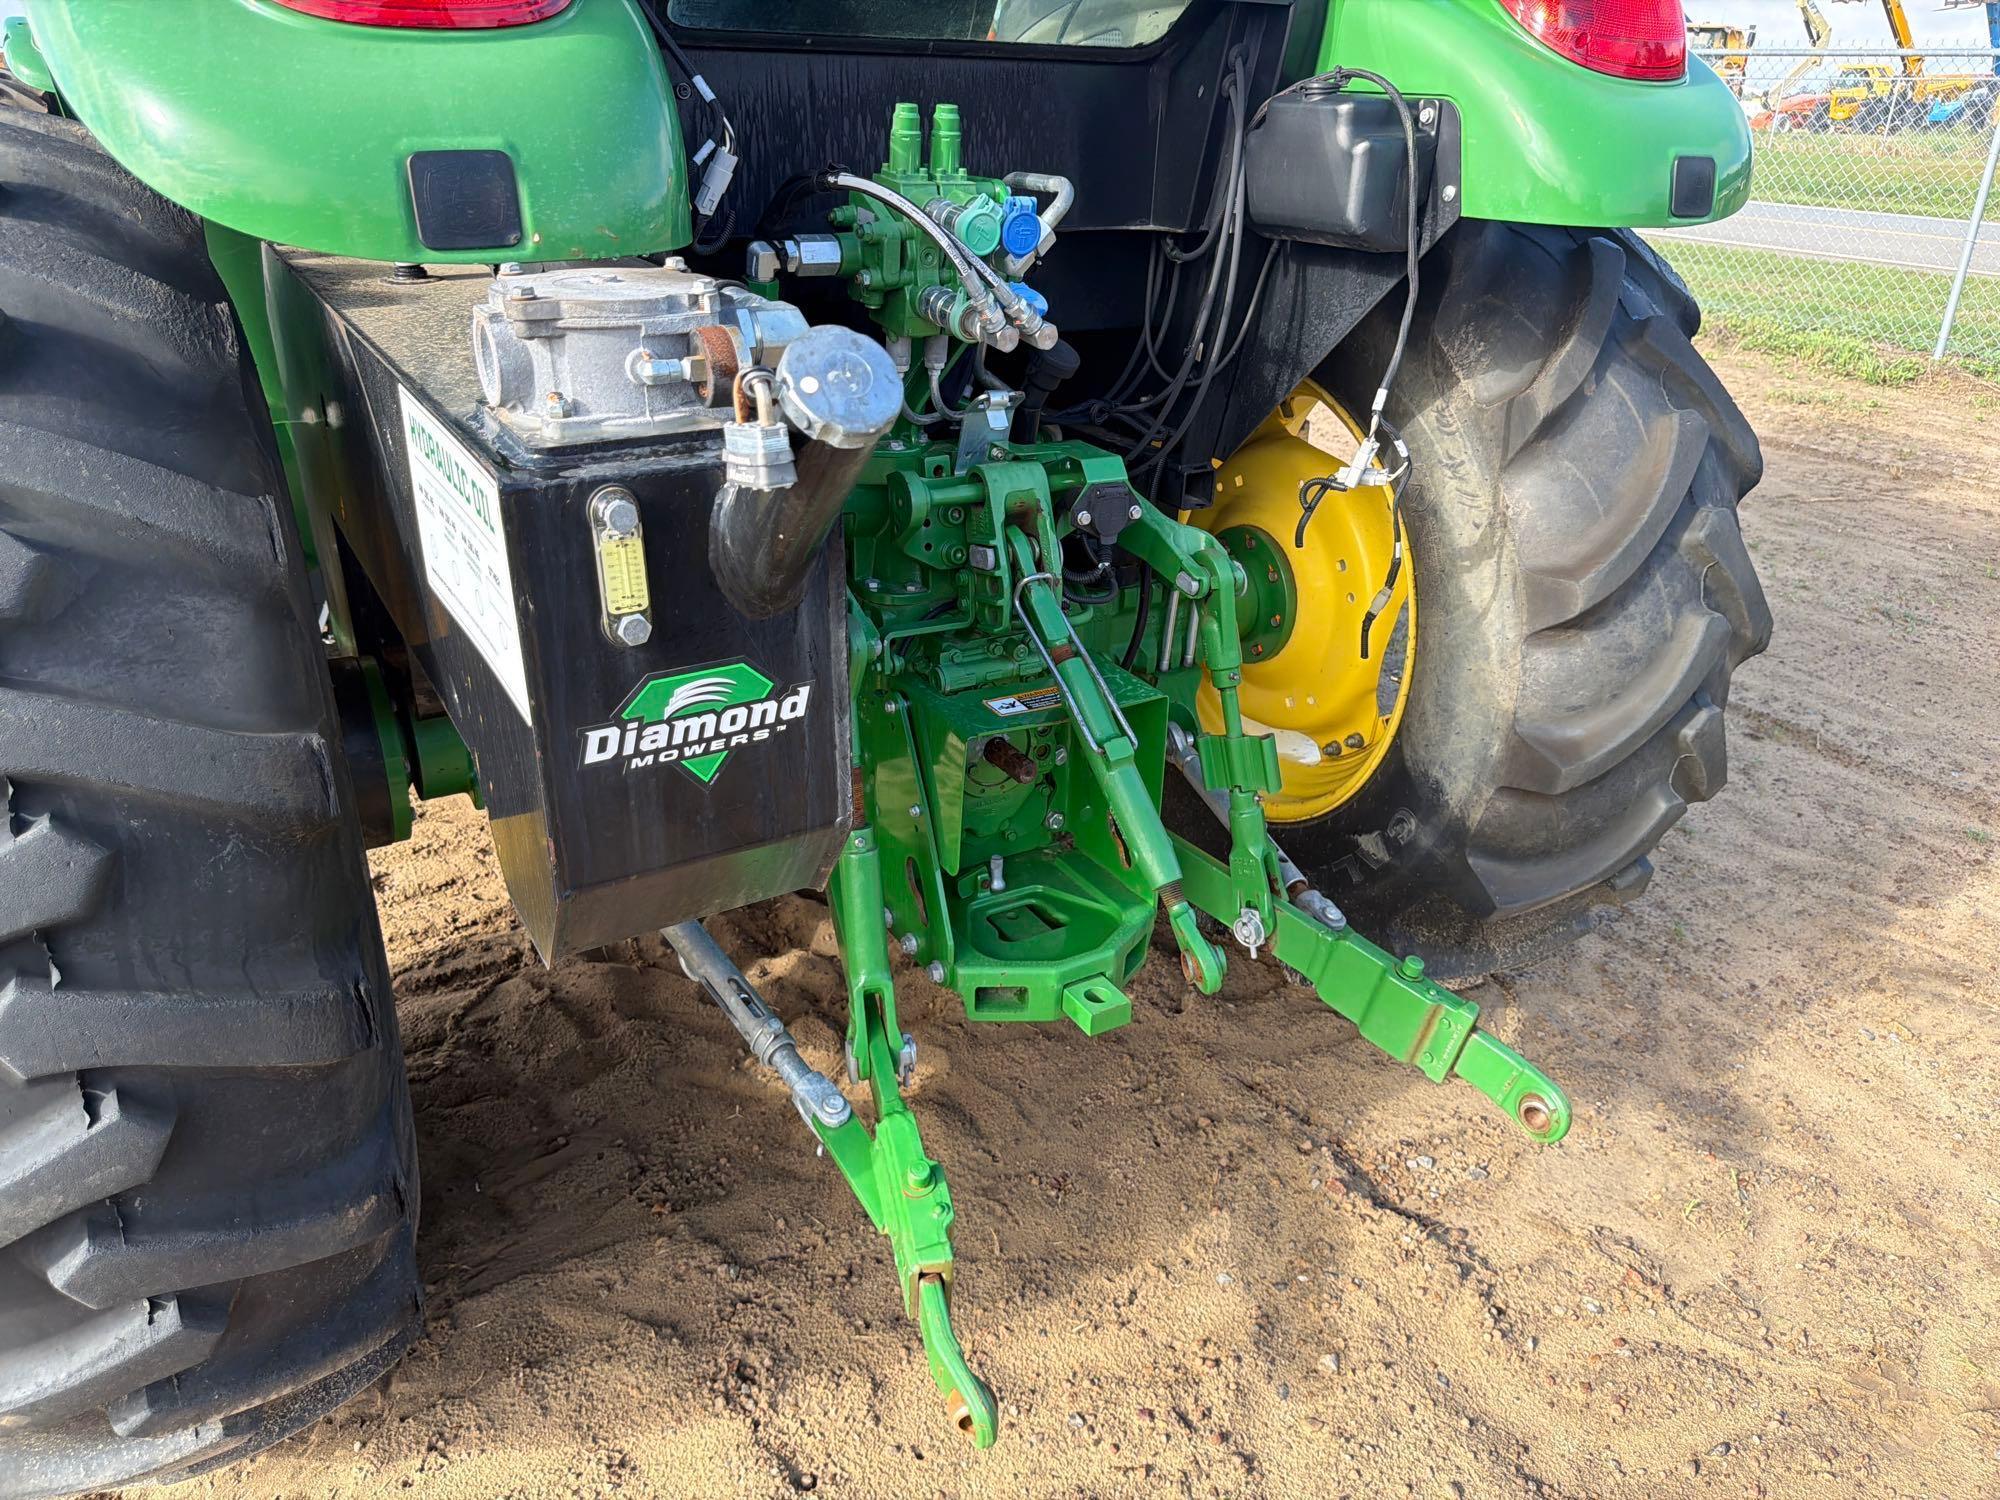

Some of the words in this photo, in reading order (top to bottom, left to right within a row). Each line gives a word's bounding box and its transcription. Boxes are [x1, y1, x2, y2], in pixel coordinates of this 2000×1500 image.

[408, 411, 472, 506] HYDRAULIC
[470, 479, 496, 534] OIL
[584, 685, 811, 765] Diamond
[630, 728, 771, 769] MOWERS
